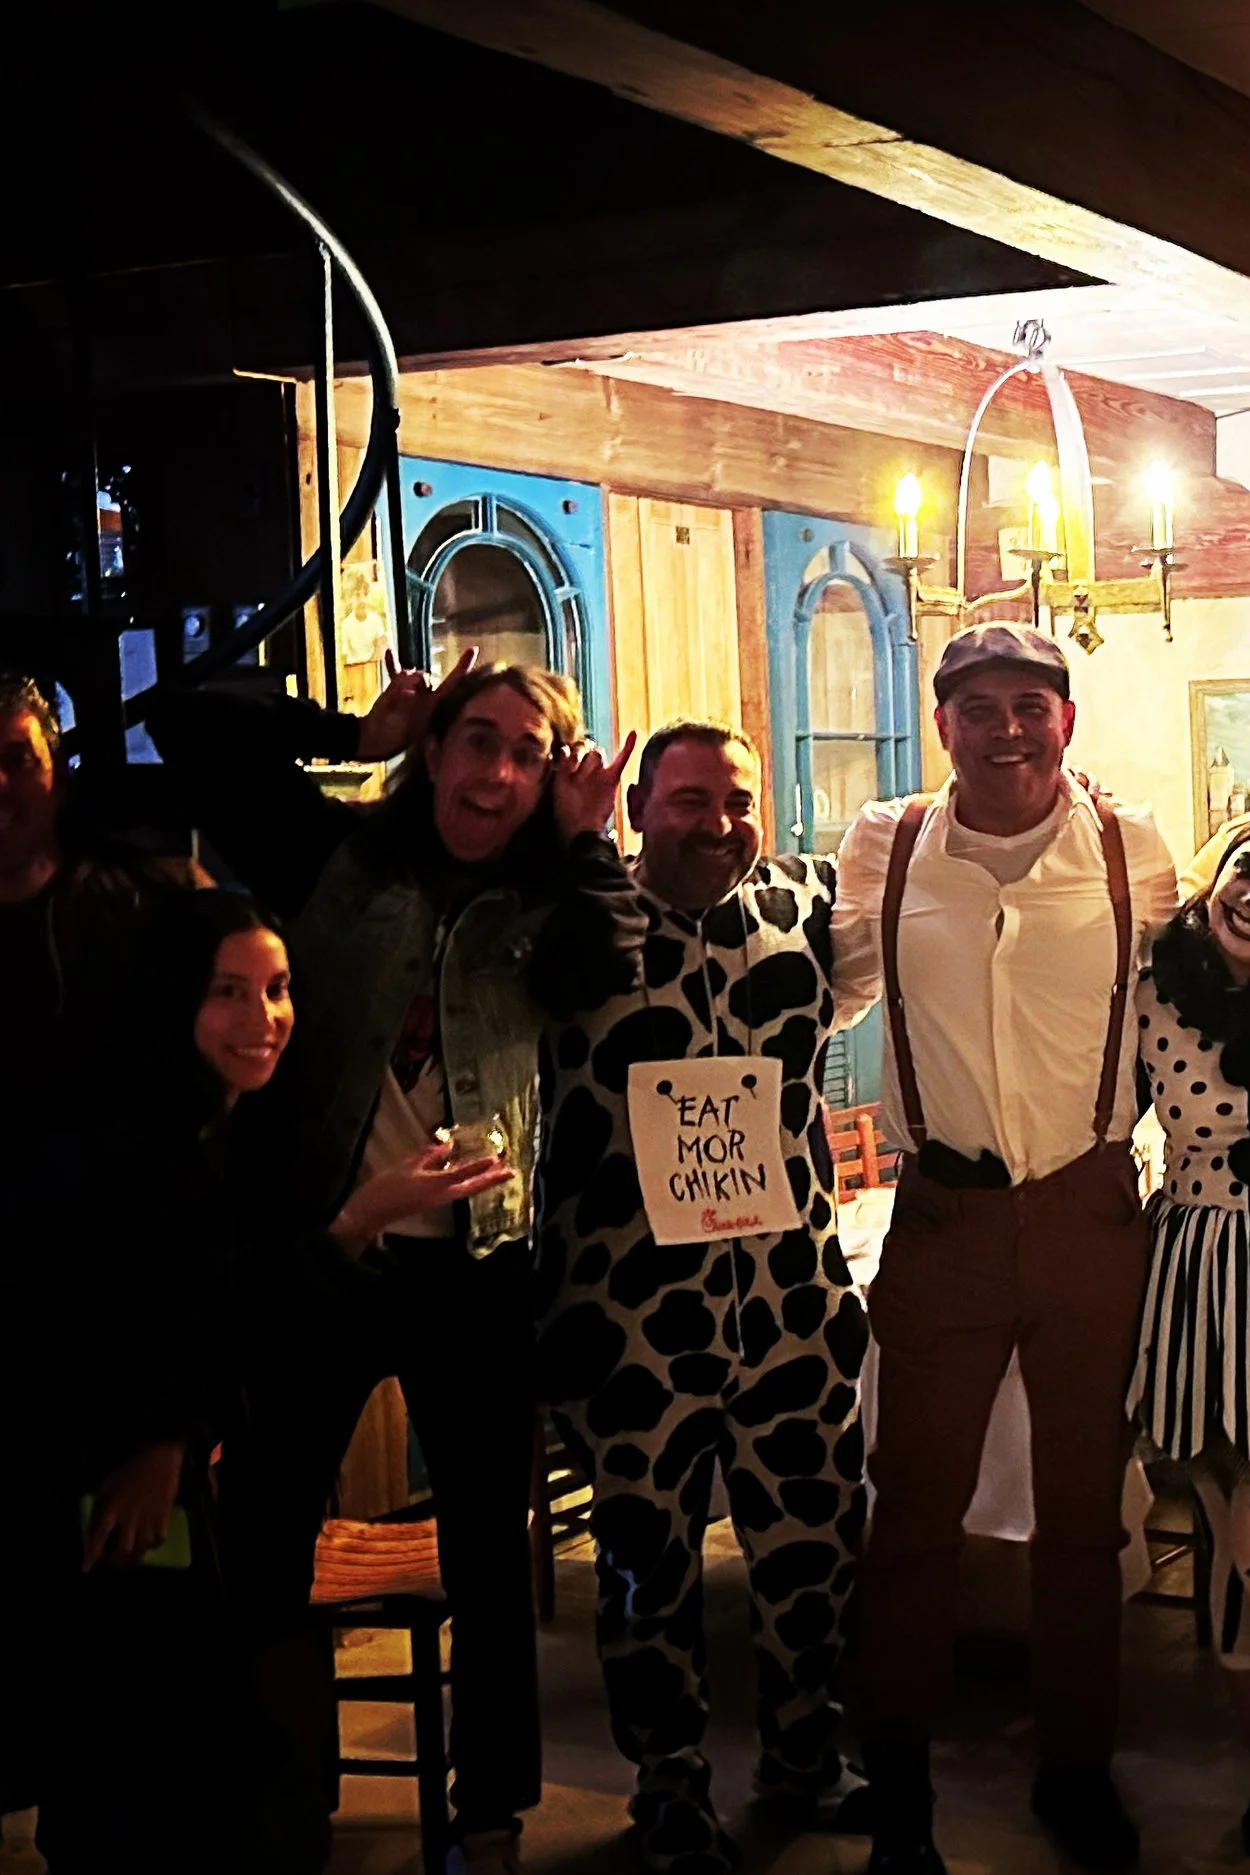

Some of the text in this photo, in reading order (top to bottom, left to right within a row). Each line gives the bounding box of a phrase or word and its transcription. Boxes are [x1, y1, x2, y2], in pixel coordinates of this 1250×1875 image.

[678, 1095, 740, 1128] EAT
[677, 1129, 746, 1168] MOR
[668, 1163, 767, 1202] CHIKIN
